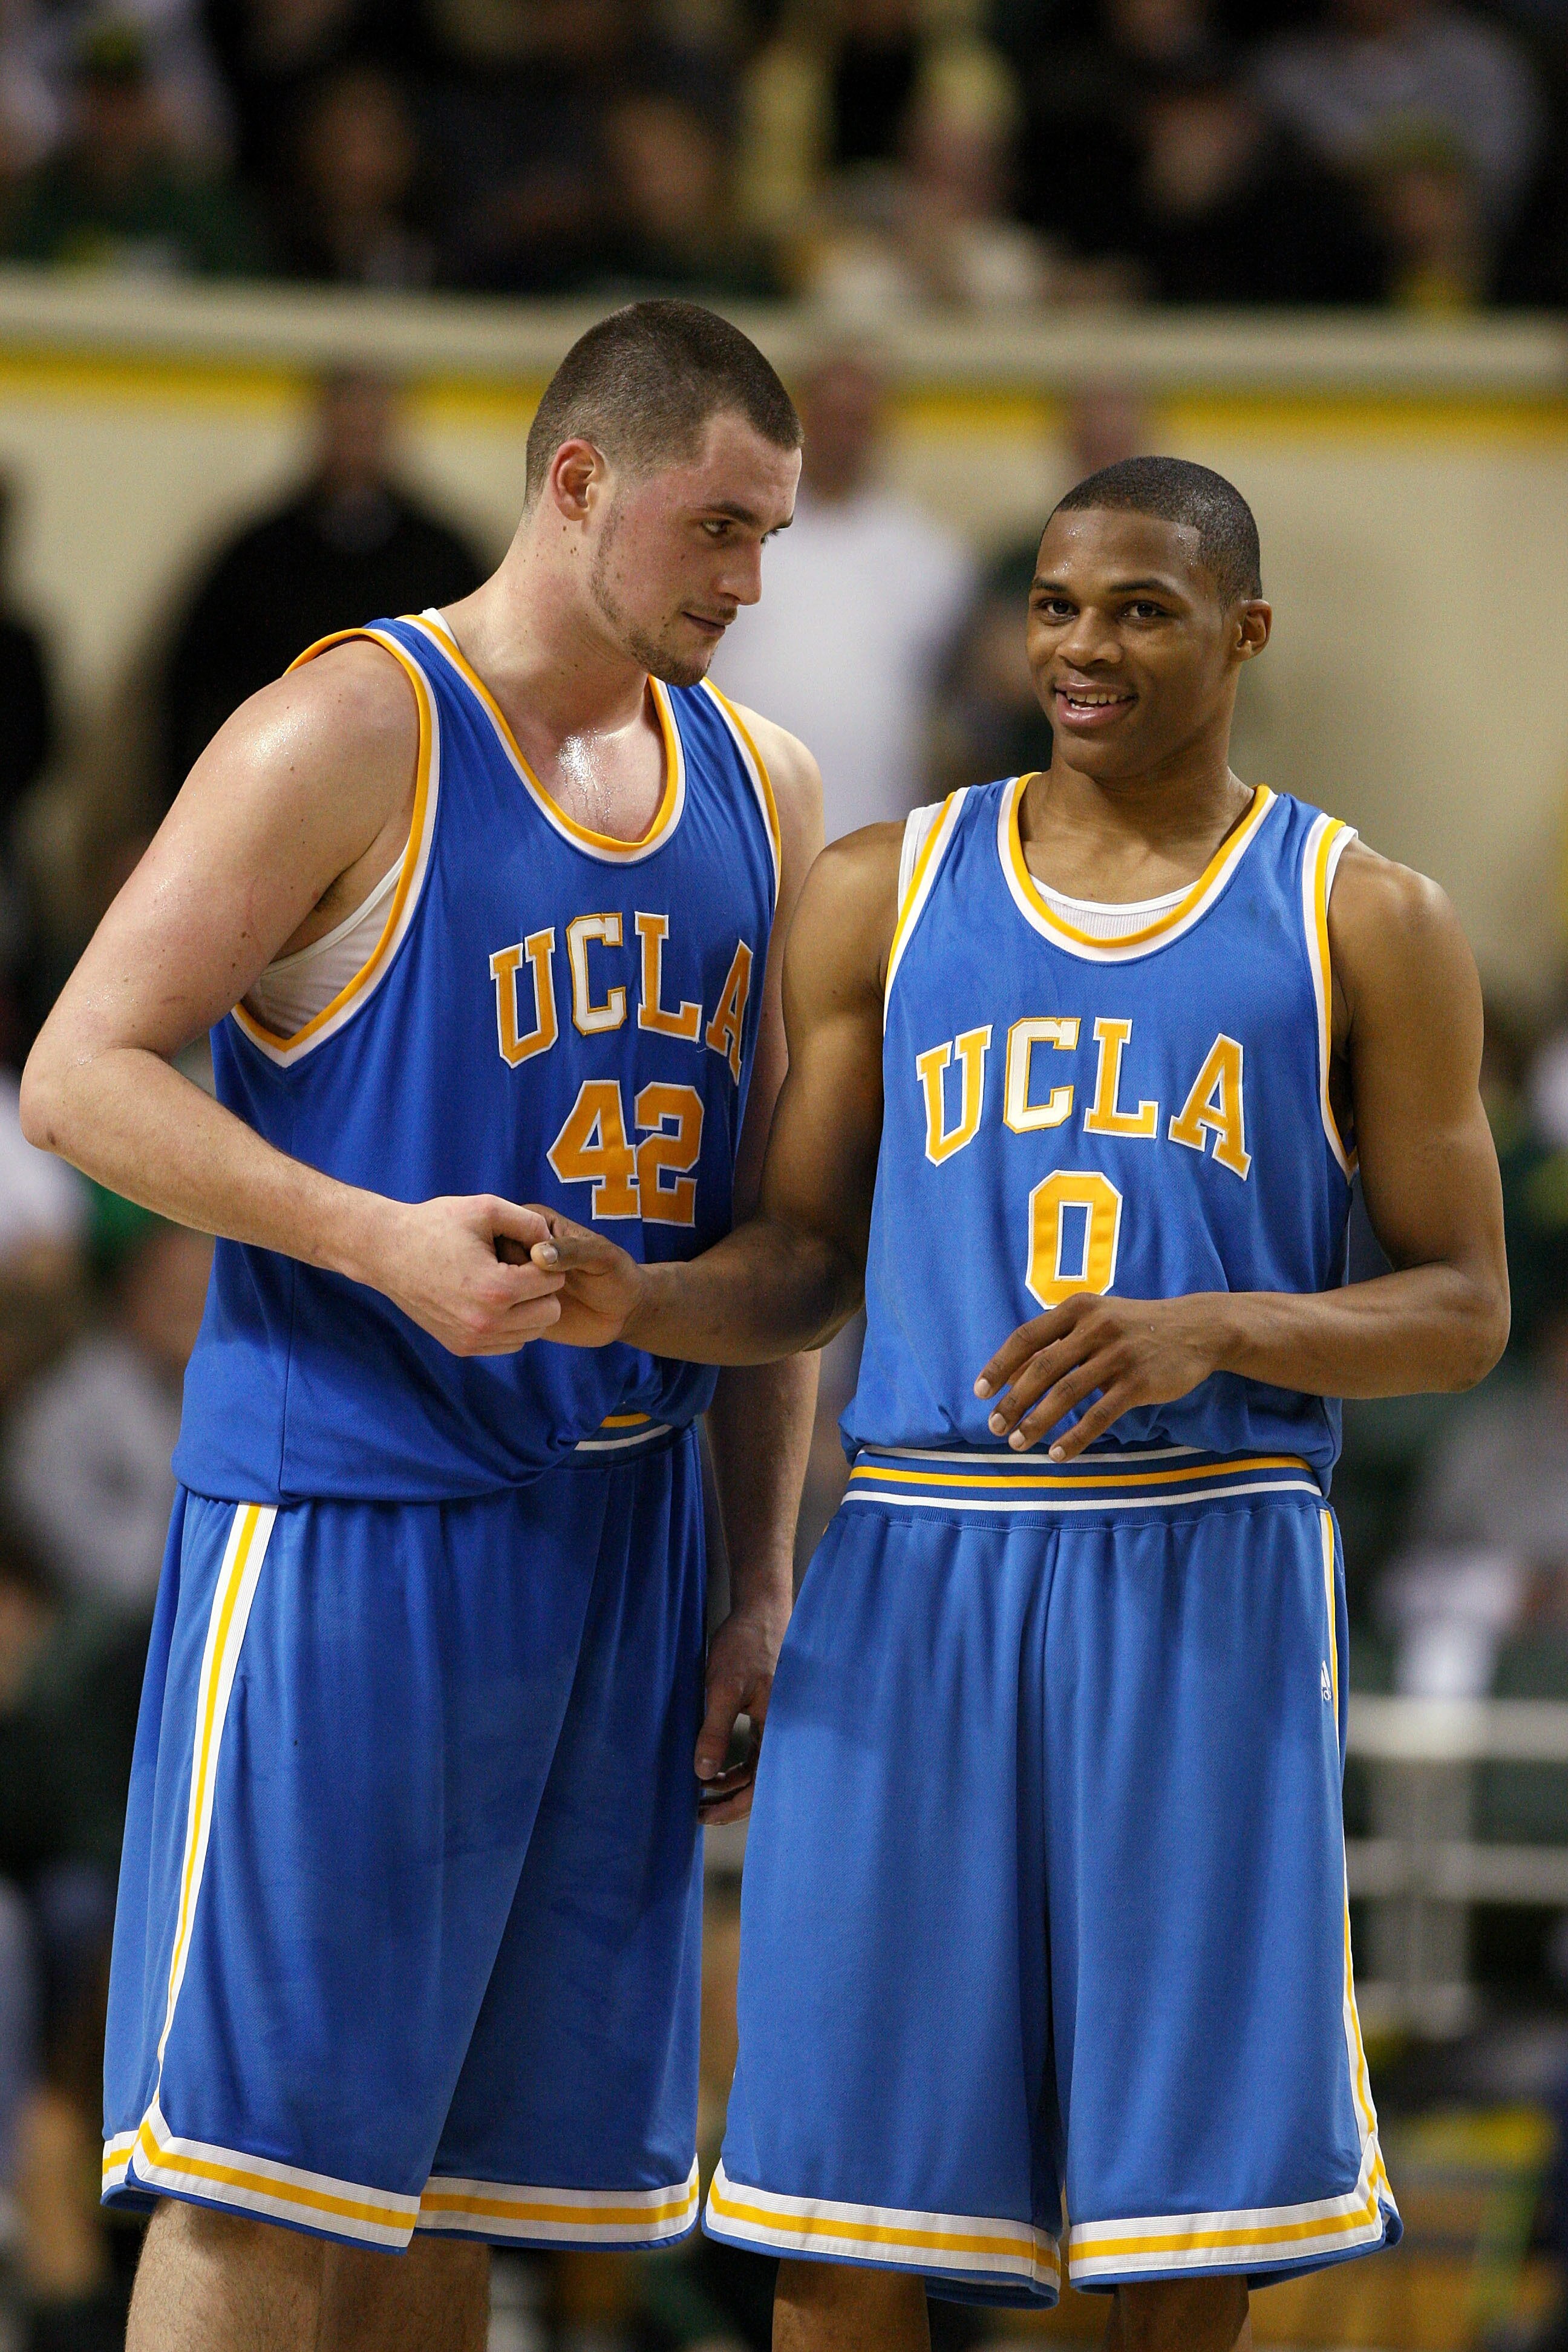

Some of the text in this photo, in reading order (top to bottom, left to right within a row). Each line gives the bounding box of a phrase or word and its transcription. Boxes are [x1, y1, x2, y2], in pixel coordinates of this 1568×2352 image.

[489, 911, 753, 1086] UCLA
[546, 1079, 704, 1227] 42
[916, 1017, 1252, 1181] UCLA
